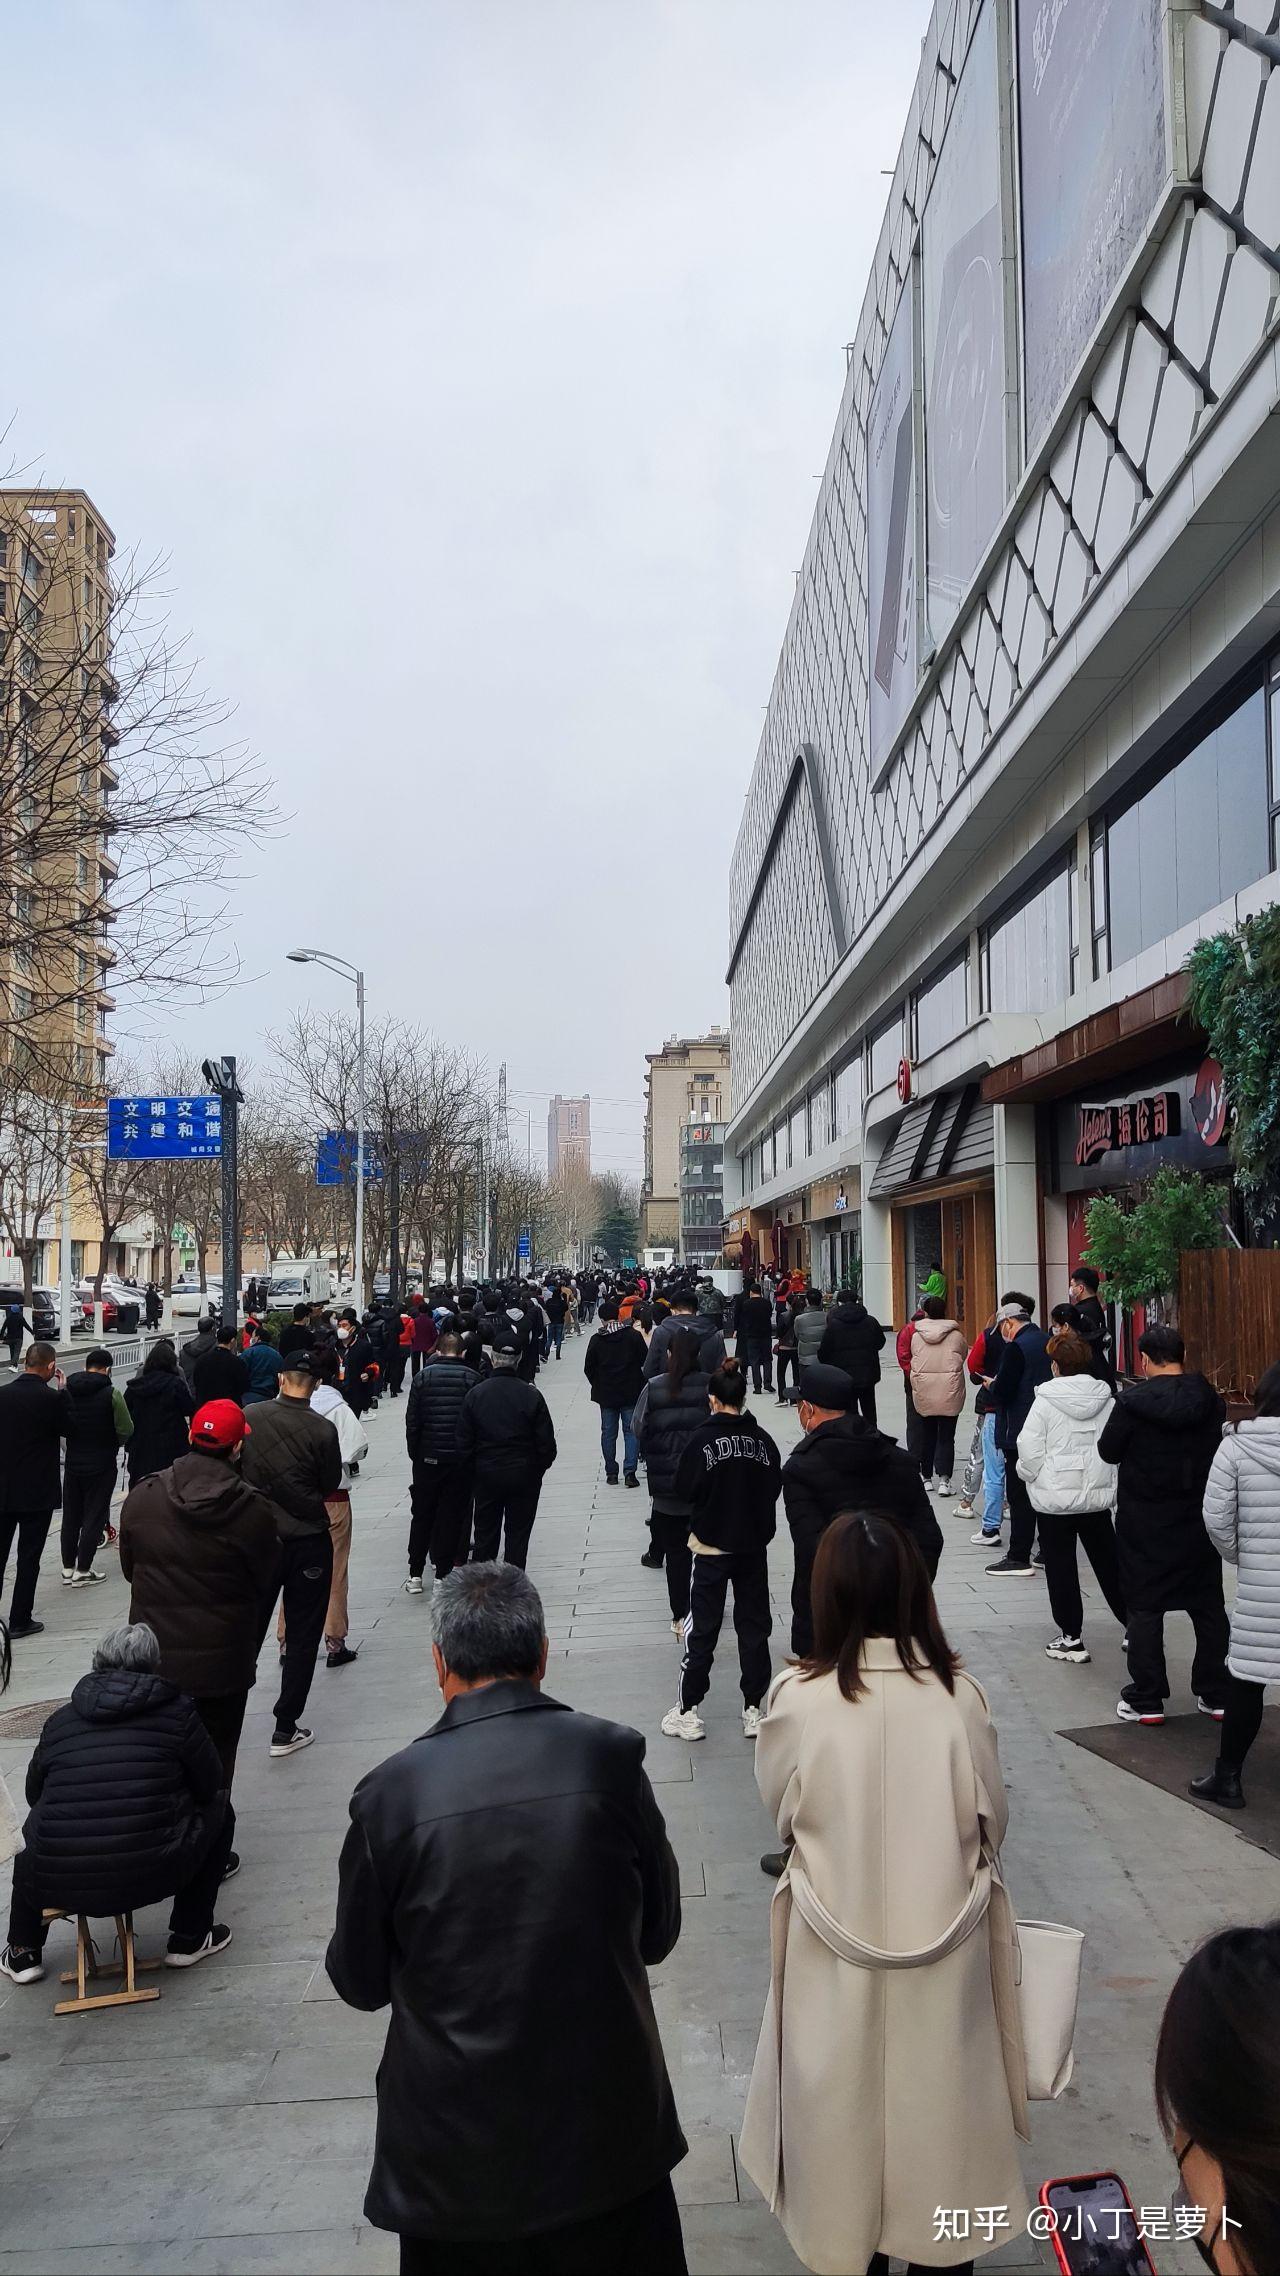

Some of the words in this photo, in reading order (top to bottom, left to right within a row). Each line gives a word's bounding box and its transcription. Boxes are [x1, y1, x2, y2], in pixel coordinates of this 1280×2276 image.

[124, 1101, 220, 1118] 文明交通
[1117, 1092, 1168, 1146] 海伦司
[124, 1121, 221, 1138] 共建和谐
